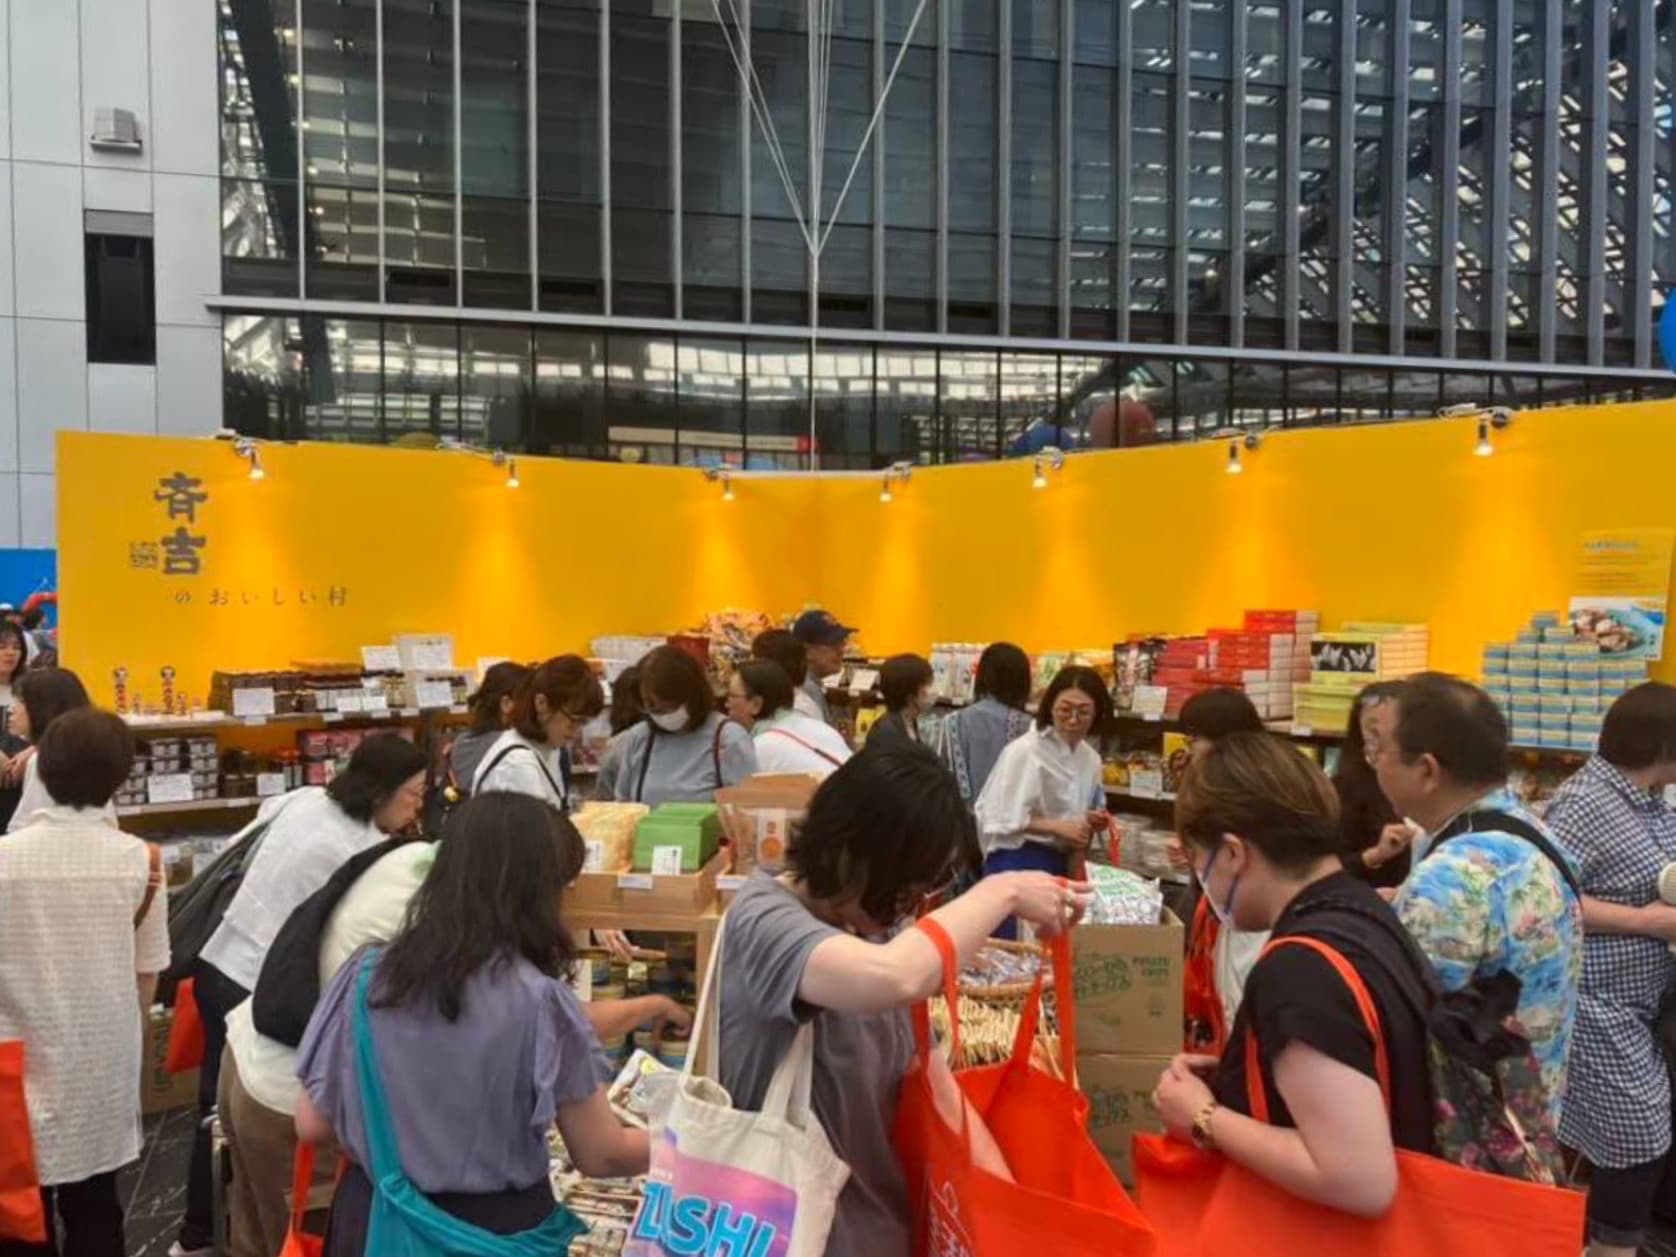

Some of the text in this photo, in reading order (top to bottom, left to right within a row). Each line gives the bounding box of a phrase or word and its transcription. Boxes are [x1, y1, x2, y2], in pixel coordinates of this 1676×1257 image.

[176, 587, 346, 606] のおいしい村
